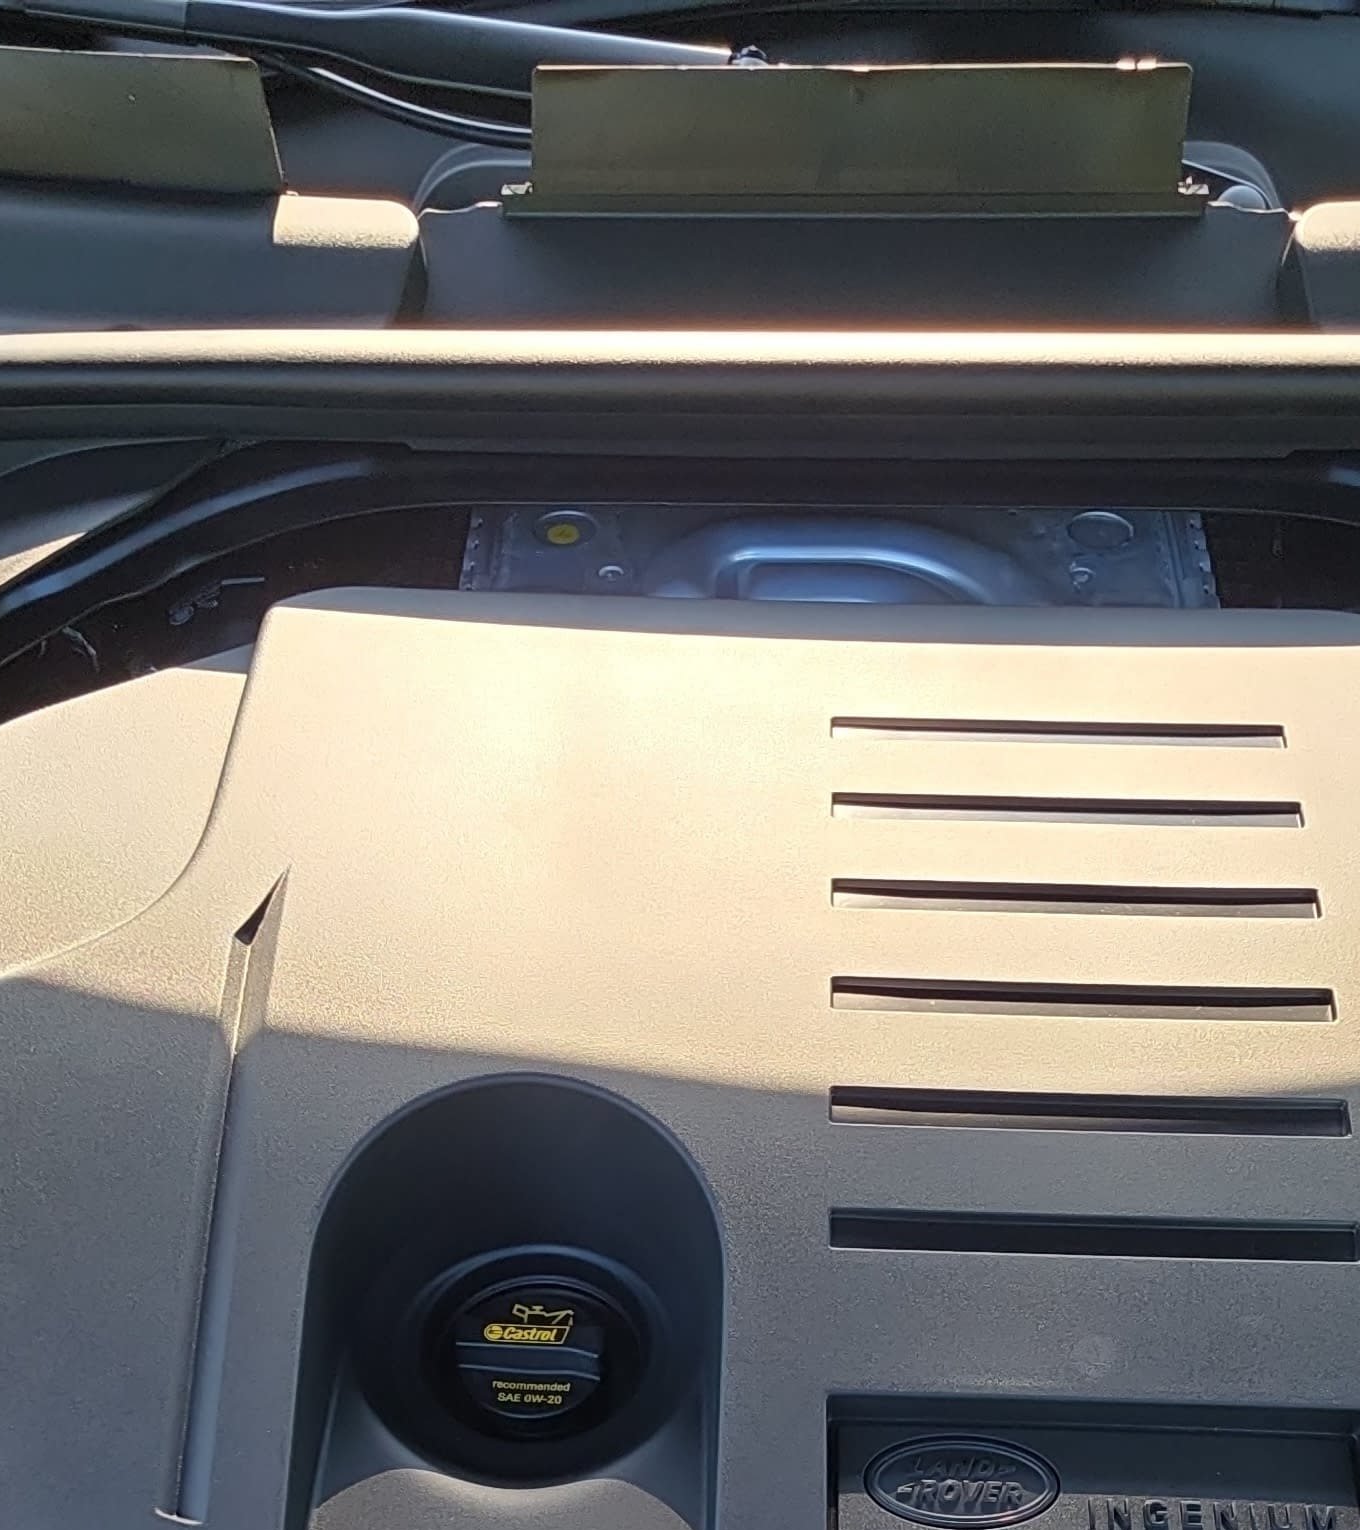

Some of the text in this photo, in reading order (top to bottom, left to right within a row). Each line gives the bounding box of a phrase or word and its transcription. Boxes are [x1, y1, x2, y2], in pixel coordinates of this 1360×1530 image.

[502, 1326, 557, 1342] Castrol
[492, 1380, 571, 1393] recommended
[497, 1392, 563, 1405] SAE 0W-20
[915, 1478, 1026, 1505] ROVER
